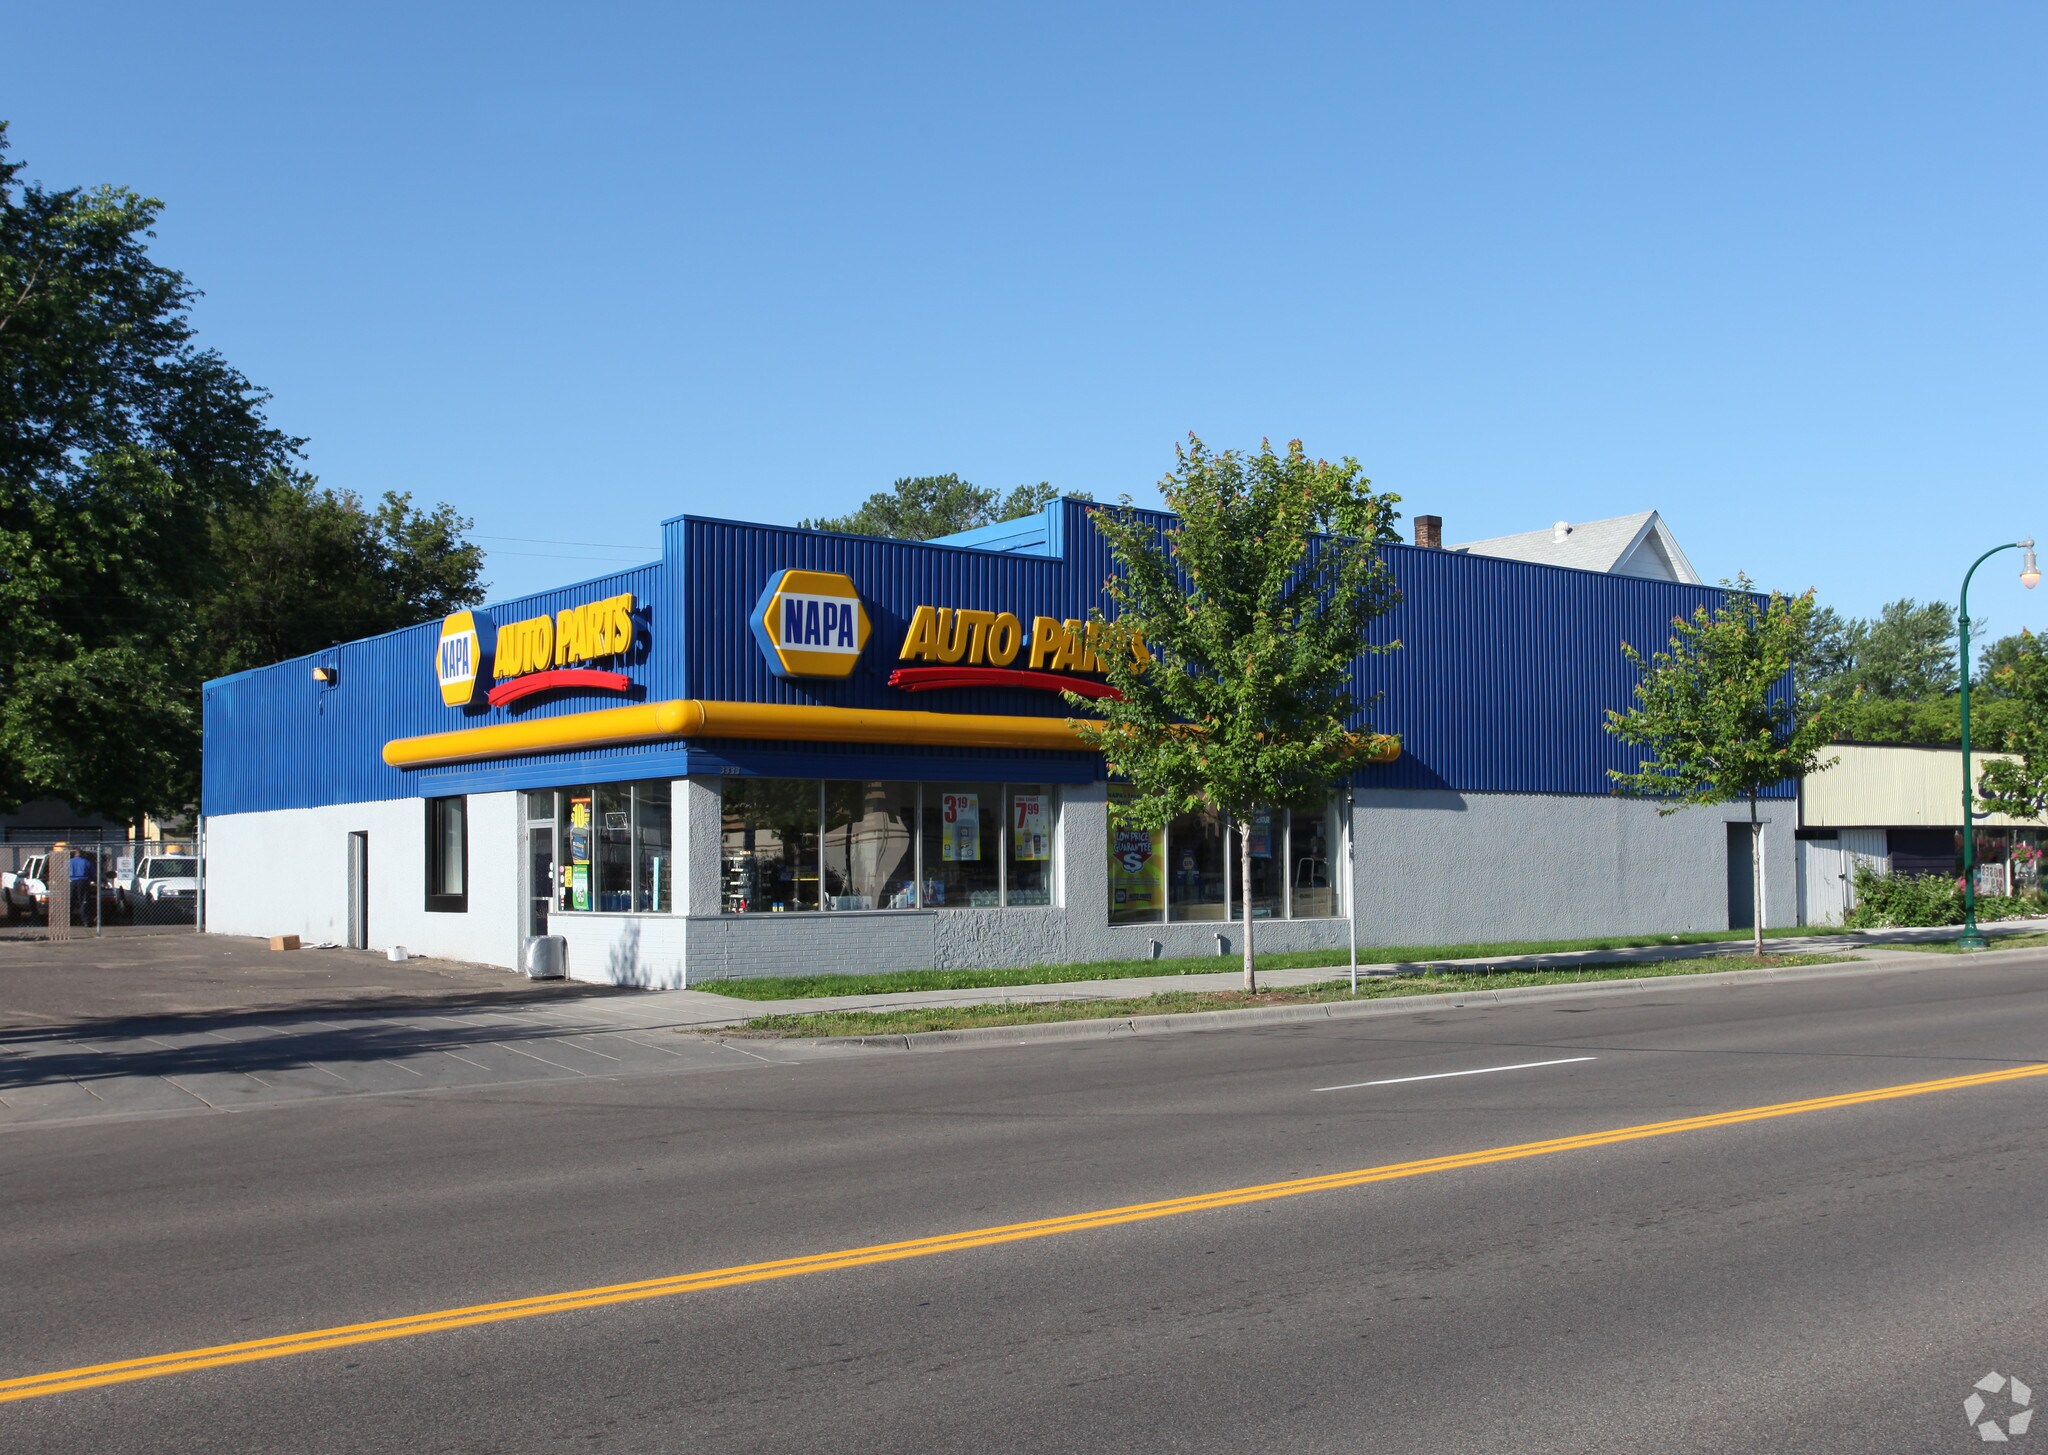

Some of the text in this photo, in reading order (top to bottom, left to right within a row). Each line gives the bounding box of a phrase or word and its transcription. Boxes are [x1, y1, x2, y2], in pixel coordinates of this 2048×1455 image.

[493, 593, 633, 680] AUTO PARTS
[784, 598, 855, 648] NAPA
[899, 604, 1022, 667] AUTO
[442, 635, 470, 680] NAPA
[1113, 842, 1152, 852] GUARANTEE
[1116, 831, 1149, 842] LOW PRICE
